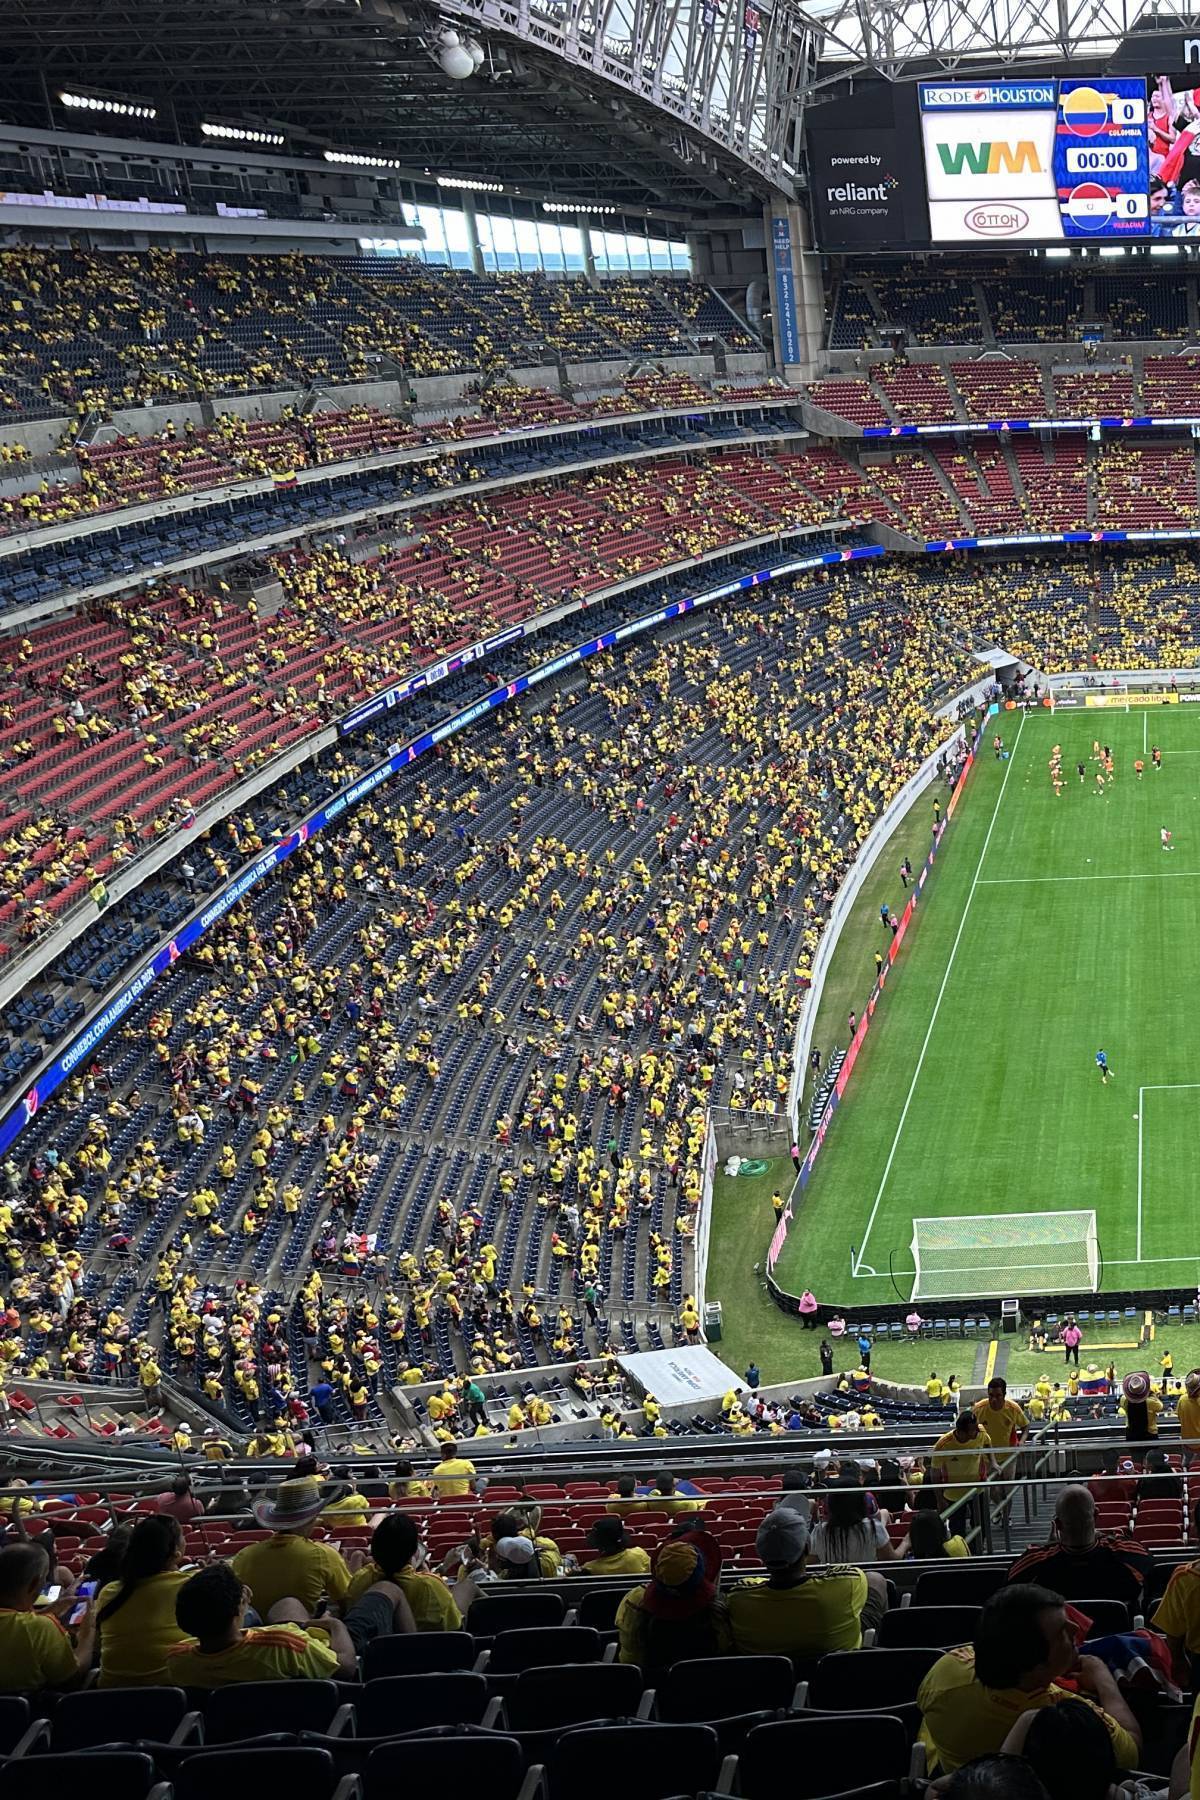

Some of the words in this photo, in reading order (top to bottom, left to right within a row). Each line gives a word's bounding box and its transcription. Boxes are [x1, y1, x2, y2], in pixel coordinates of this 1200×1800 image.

[989, 88, 1053, 103] HOUSTON
[1123, 104, 1134, 120] 0
[1108, 129, 1142, 137] COLOMBIA
[831, 155, 869, 166] powered
[870, 155, 881, 166] by
[936, 141, 1042, 175] WM
[1077, 152, 1128, 168] 00:00
[827, 183, 888, 201] reliant
[839, 207, 856, 215] NRG
[856, 208, 889, 216] company
[1126, 199, 1137, 214] 0
[1111, 695, 1150, 703] mercado
[1151, 694, 1171, 702] libre
[61, 1031, 96, 1072] CONMEBOL
[93, 1014, 111, 1038] COPA
[108, 990, 134, 1020] AMERICA
[131, 979, 144, 997] USA
